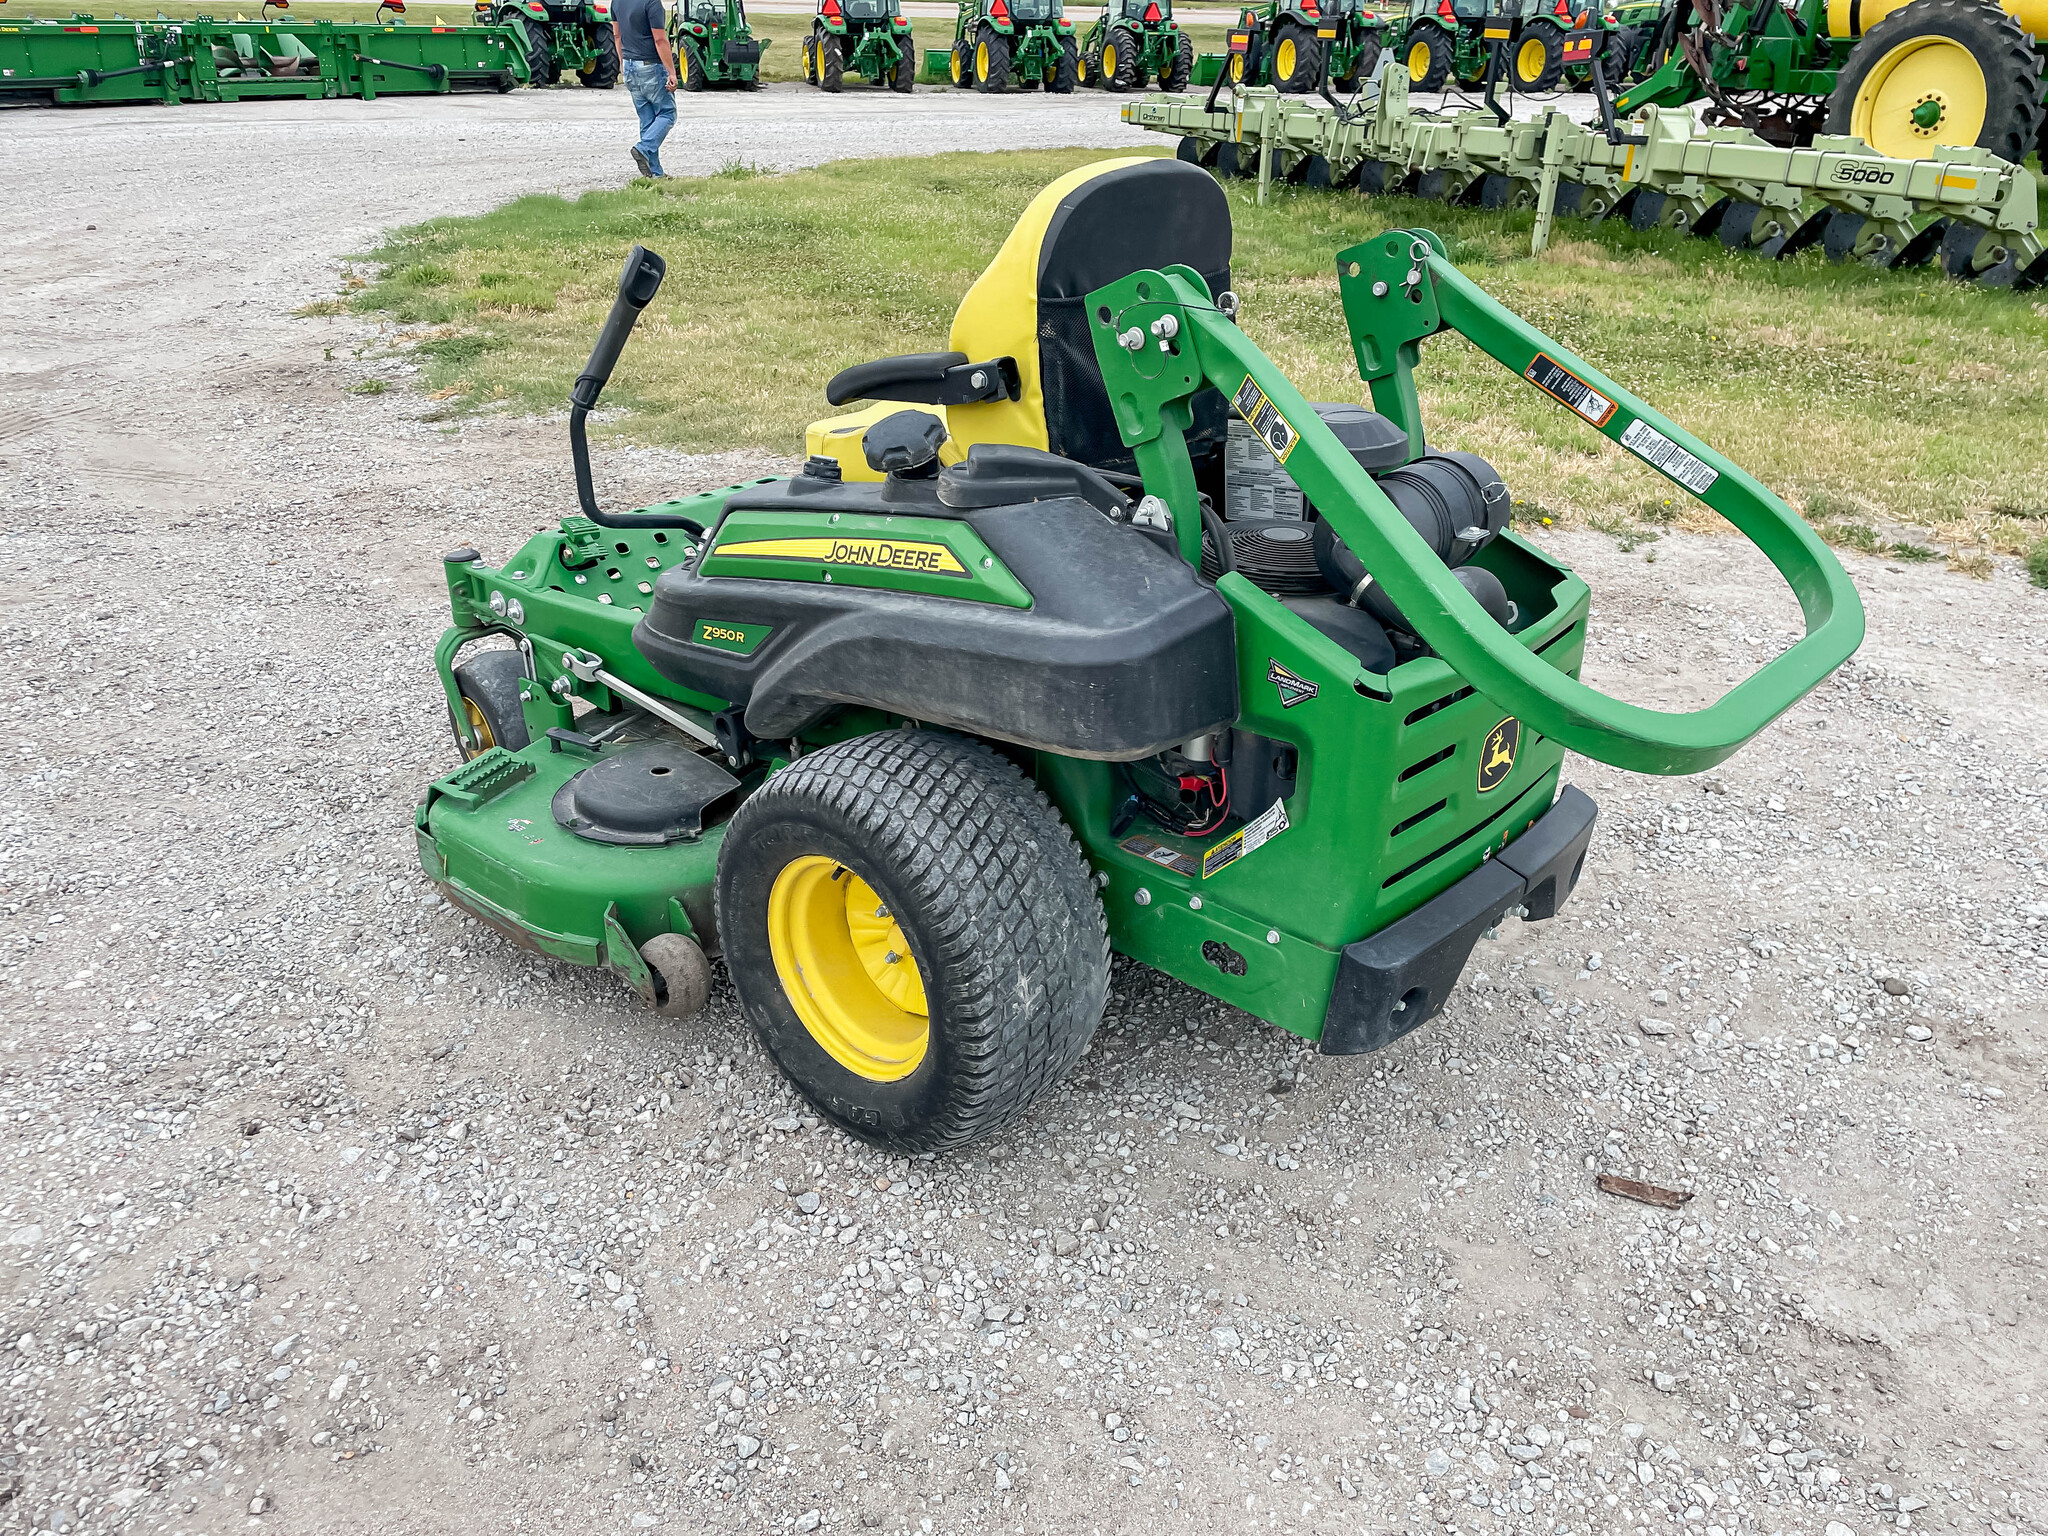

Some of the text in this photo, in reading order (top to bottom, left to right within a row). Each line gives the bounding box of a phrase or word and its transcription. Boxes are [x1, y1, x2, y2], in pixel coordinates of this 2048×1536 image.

[1839, 168, 1894, 184] 5000
[1281, 440, 1296, 461] CAUTION
[824, 541, 942, 569] JOHN DEERE
[703, 625, 745, 643] Z950R
[1270, 672, 1315, 693] LANDMARK
